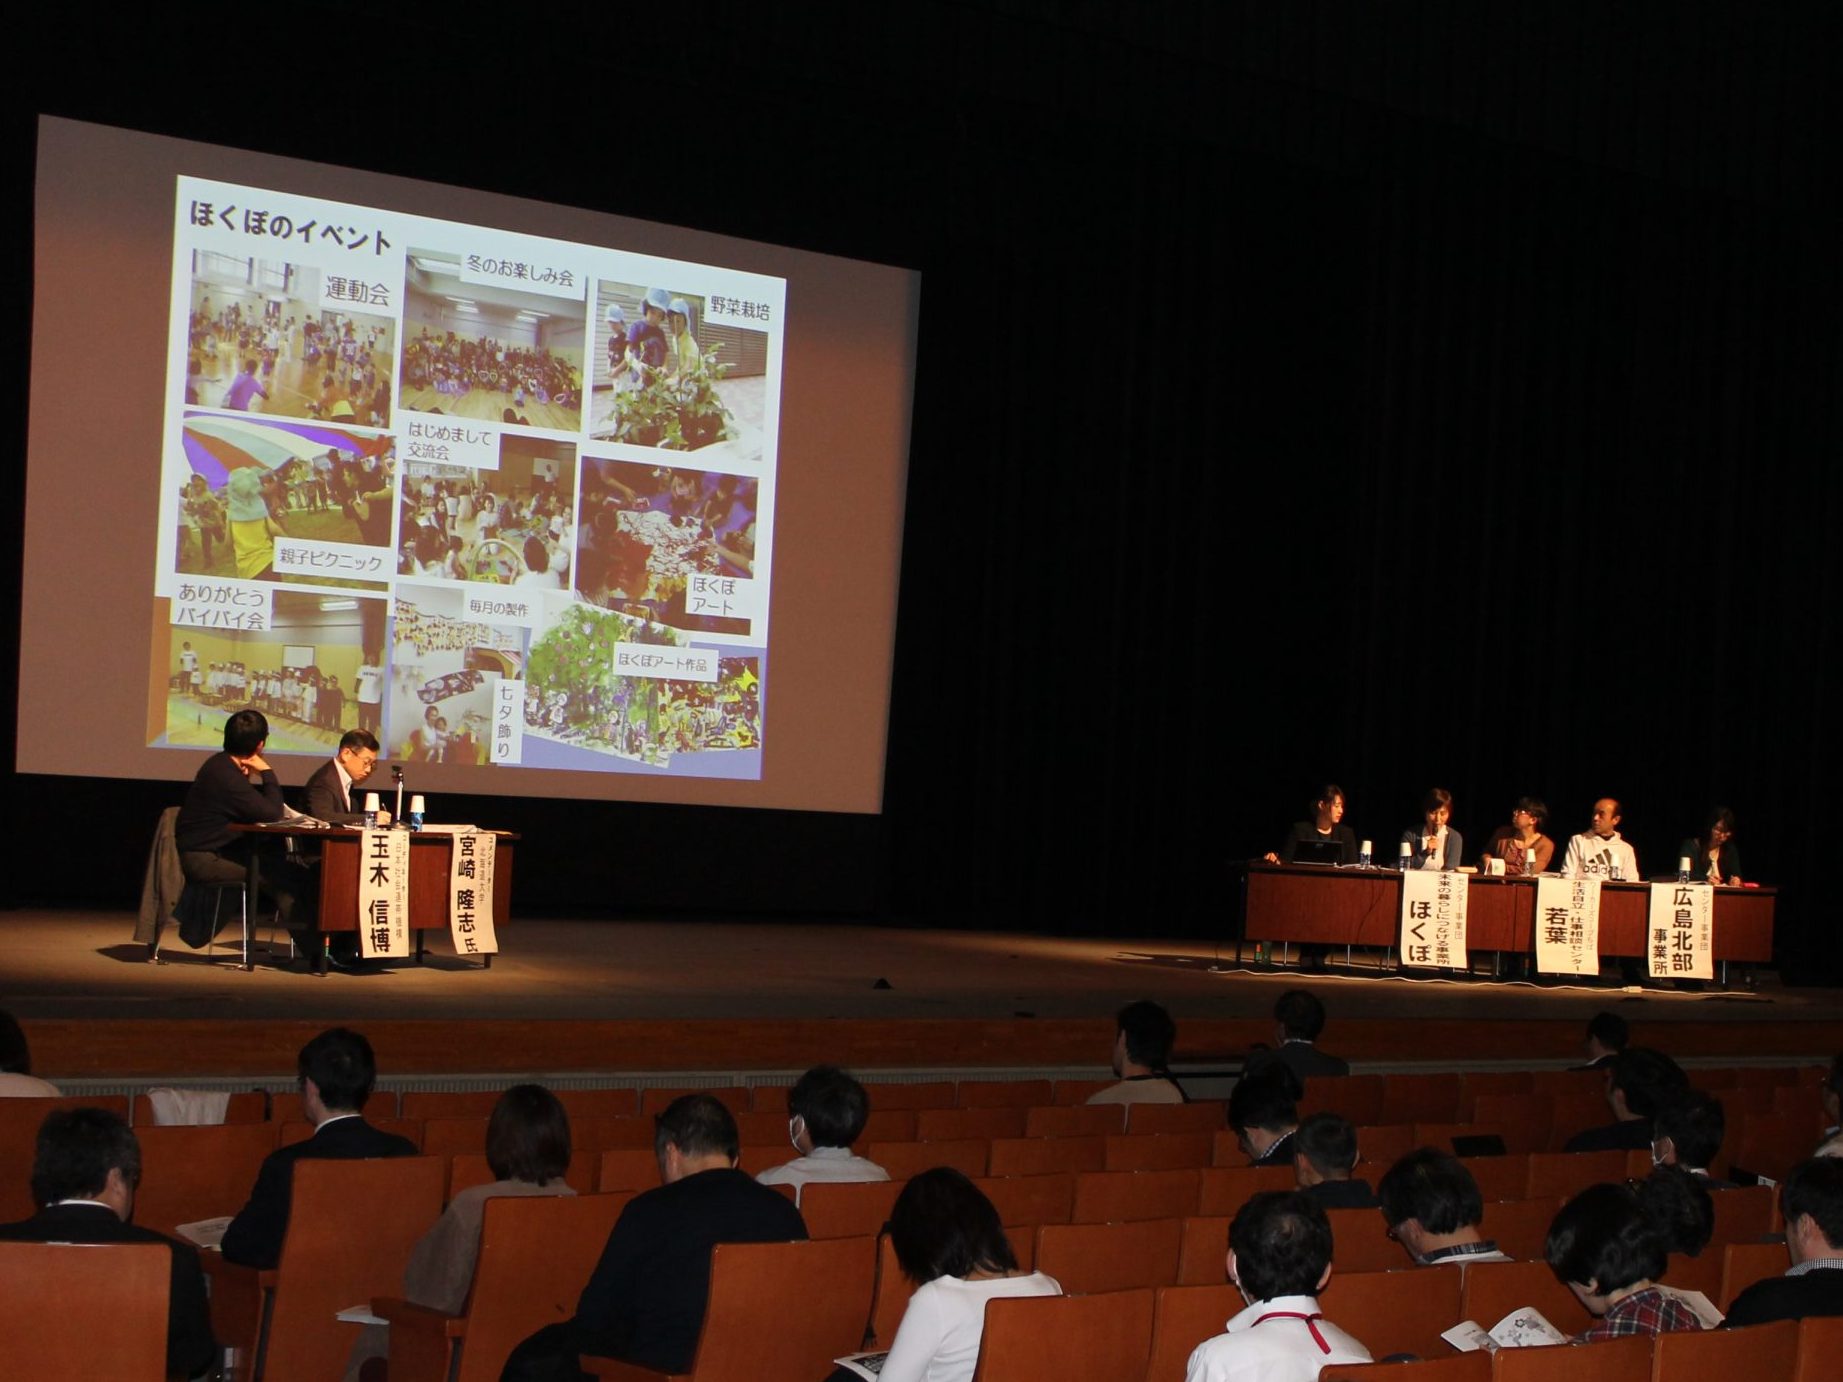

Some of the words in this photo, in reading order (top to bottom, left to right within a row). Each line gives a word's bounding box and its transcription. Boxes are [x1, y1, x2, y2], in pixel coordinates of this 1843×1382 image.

[190, 199, 392, 256] ほくぽのイベント
[466, 253, 576, 288] 冬のお楽しみ会
[325, 275, 391, 307] 運動会
[710, 294, 771, 322] 野菜栽培
[407, 440, 450, 462] 交流会
[408, 420, 492, 447] はじめまして
[280, 546, 383, 573] 親子ピクニック
[178, 582, 265, 607] ありがとう
[469, 598, 530, 618] 毎月の製作
[692, 596, 734, 616] アート
[177, 606, 265, 630] バイバイ会
[497, 685, 514, 759] 七夕飾り
[369, 834, 390, 888] 玉木
[457, 835, 477, 880] 宮崎
[368, 899, 391, 954] 信博
[457, 888, 476, 933] 隆志
[1544, 907, 1569, 945] 若葉
[1699, 889, 1709, 951] センター事業団
[464, 937, 479, 954] 氏
[1408, 900, 1432, 963] ほくぽ
[1671, 886, 1694, 972] 広島北部
[1652, 928, 1668, 976] 事業所
